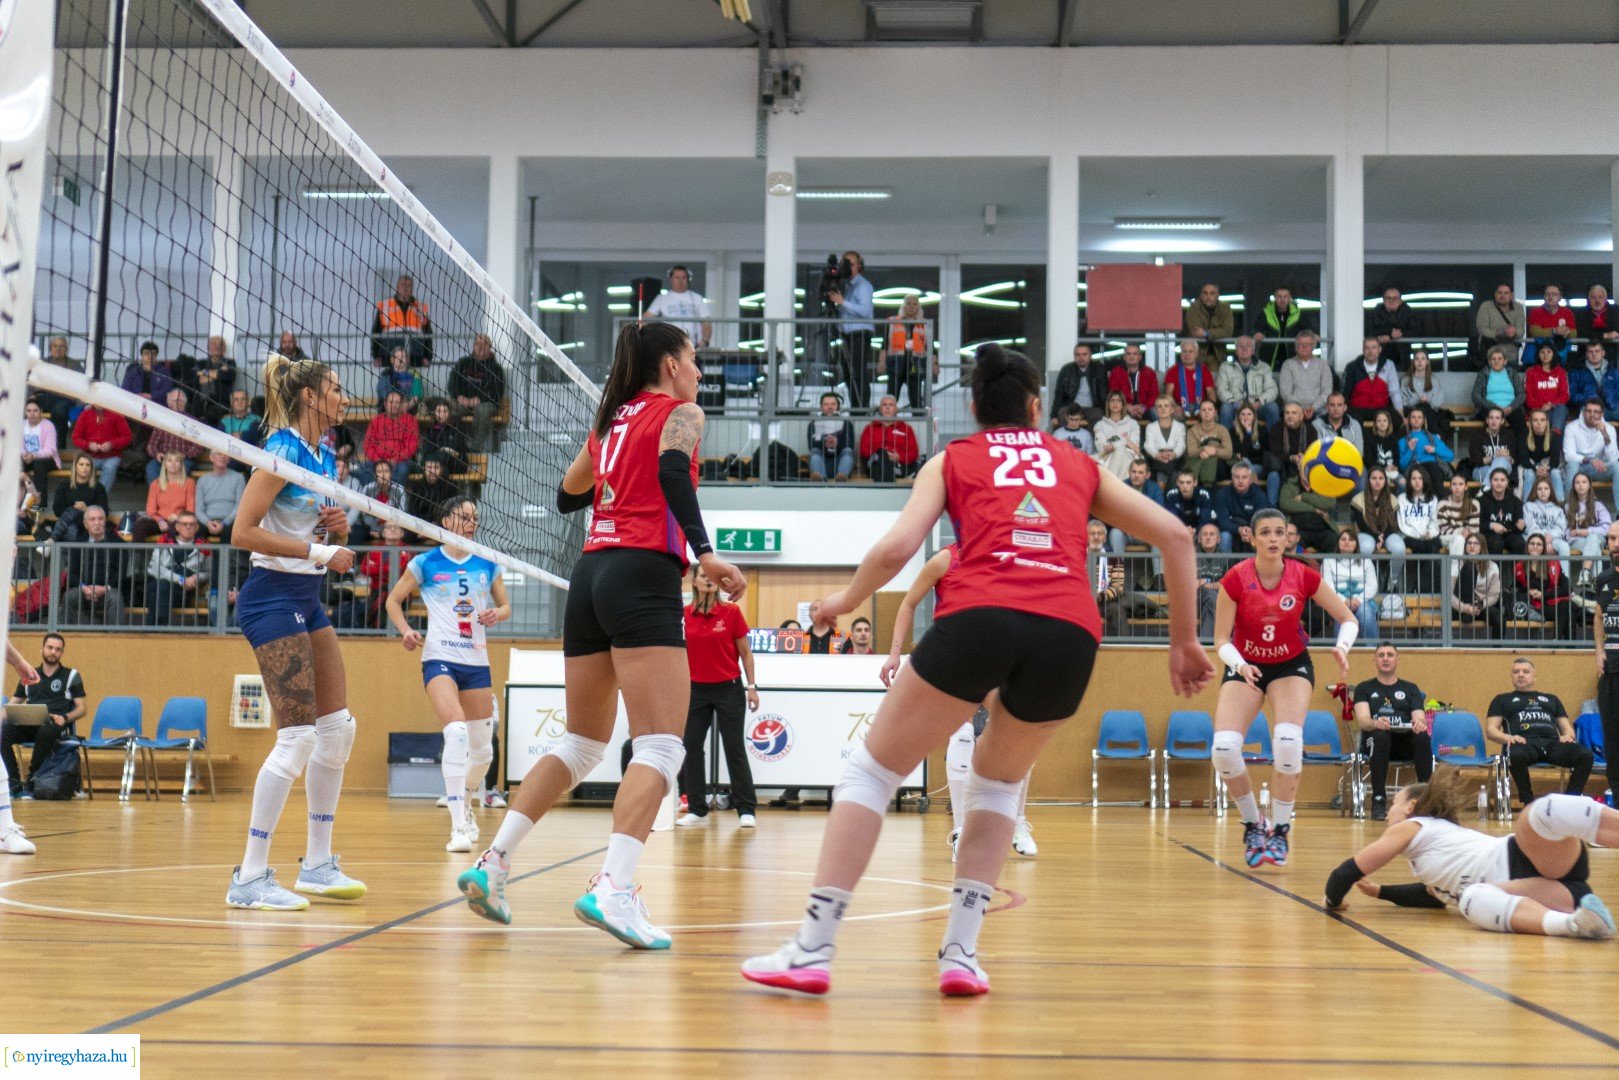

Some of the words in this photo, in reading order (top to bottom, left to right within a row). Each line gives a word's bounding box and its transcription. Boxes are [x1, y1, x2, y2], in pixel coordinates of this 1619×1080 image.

[986, 432, 1042, 445] LEBAN
[600, 422, 629, 475] 17
[988, 445, 1058, 488] 23
[459, 578, 469, 596] 5
[1262, 624, 1276, 642] 3
[784, 636, 796, 651] 0
[1243, 639, 1290, 658] FATUM
[758, 714, 783, 722] FATUM
[1518, 711, 1551, 722] FATUM
